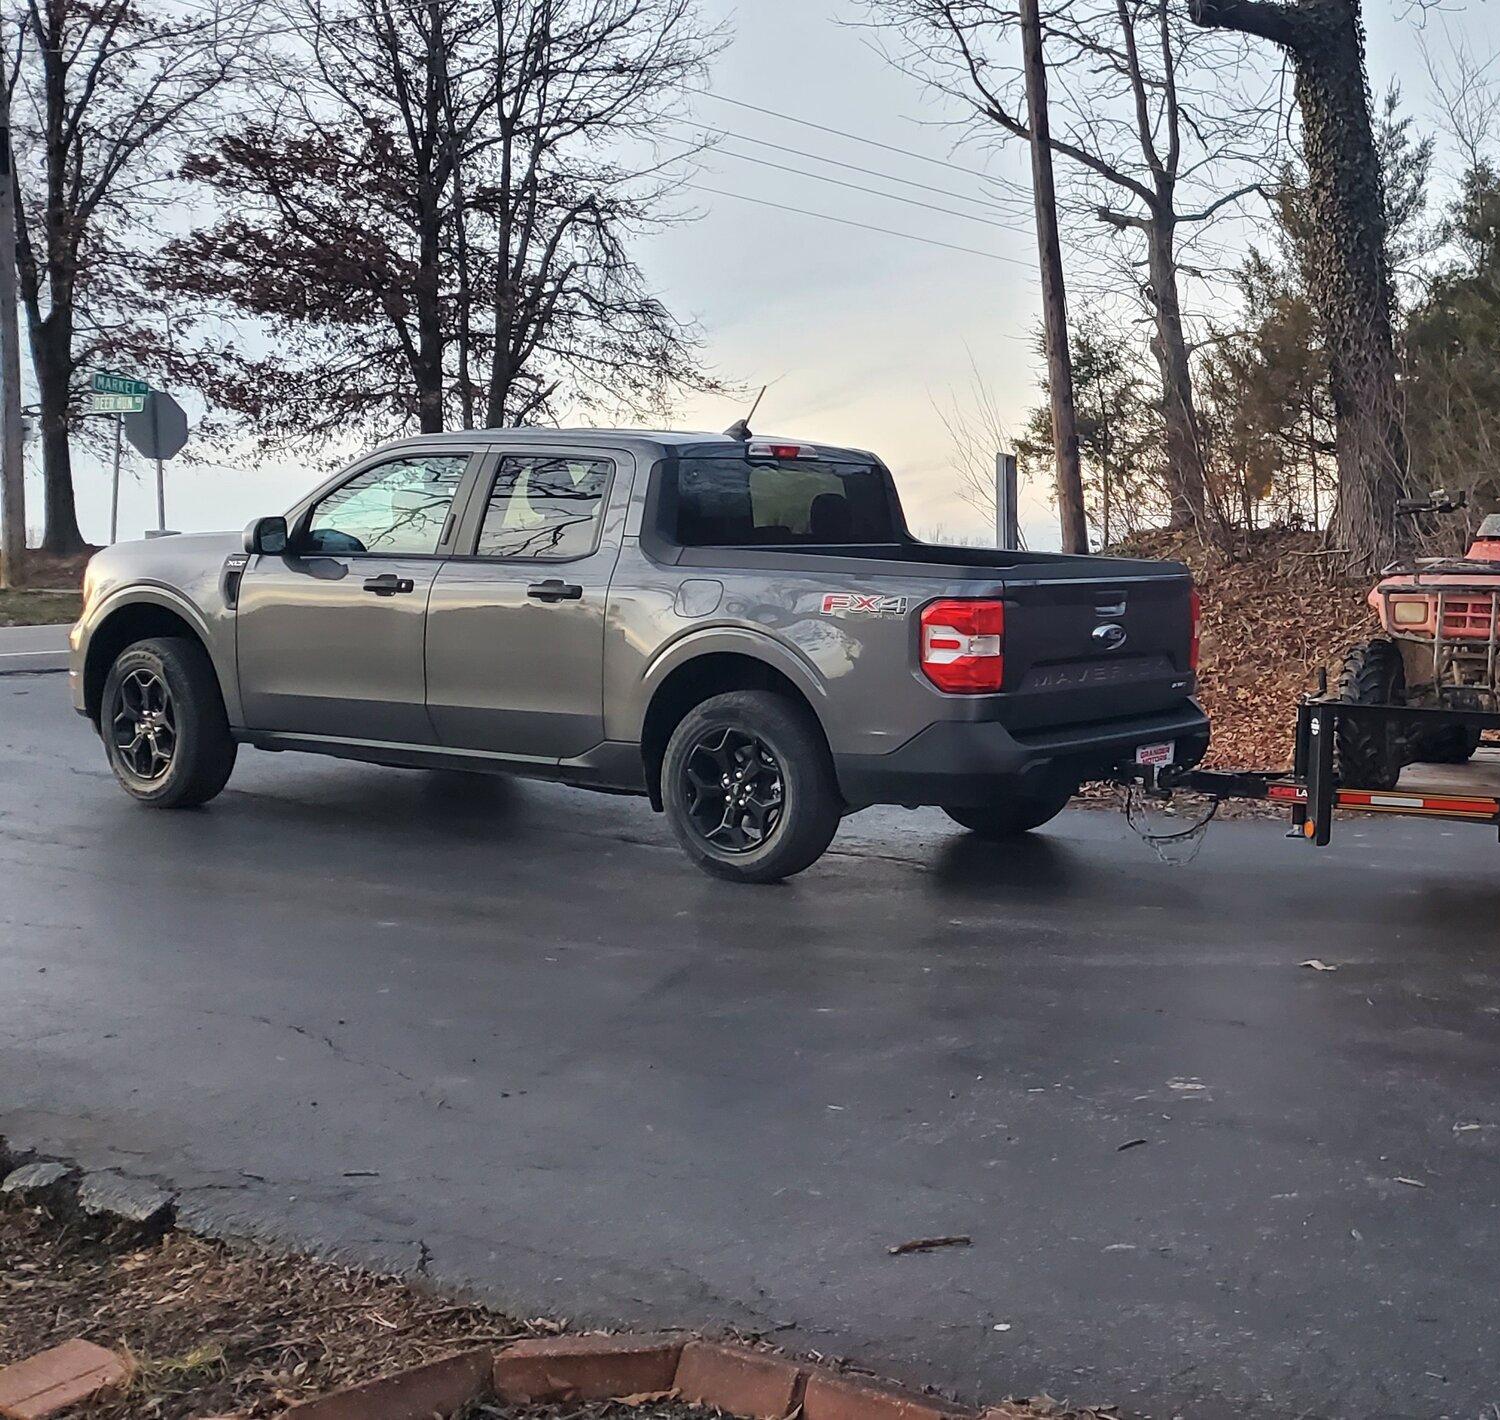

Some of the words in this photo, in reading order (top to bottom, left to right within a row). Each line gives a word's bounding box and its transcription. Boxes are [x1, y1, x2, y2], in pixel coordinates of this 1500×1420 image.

[97, 376, 136, 394] MARKET
[820, 593, 908, 617] FX4
[1034, 659, 1164, 688] MAVERC
